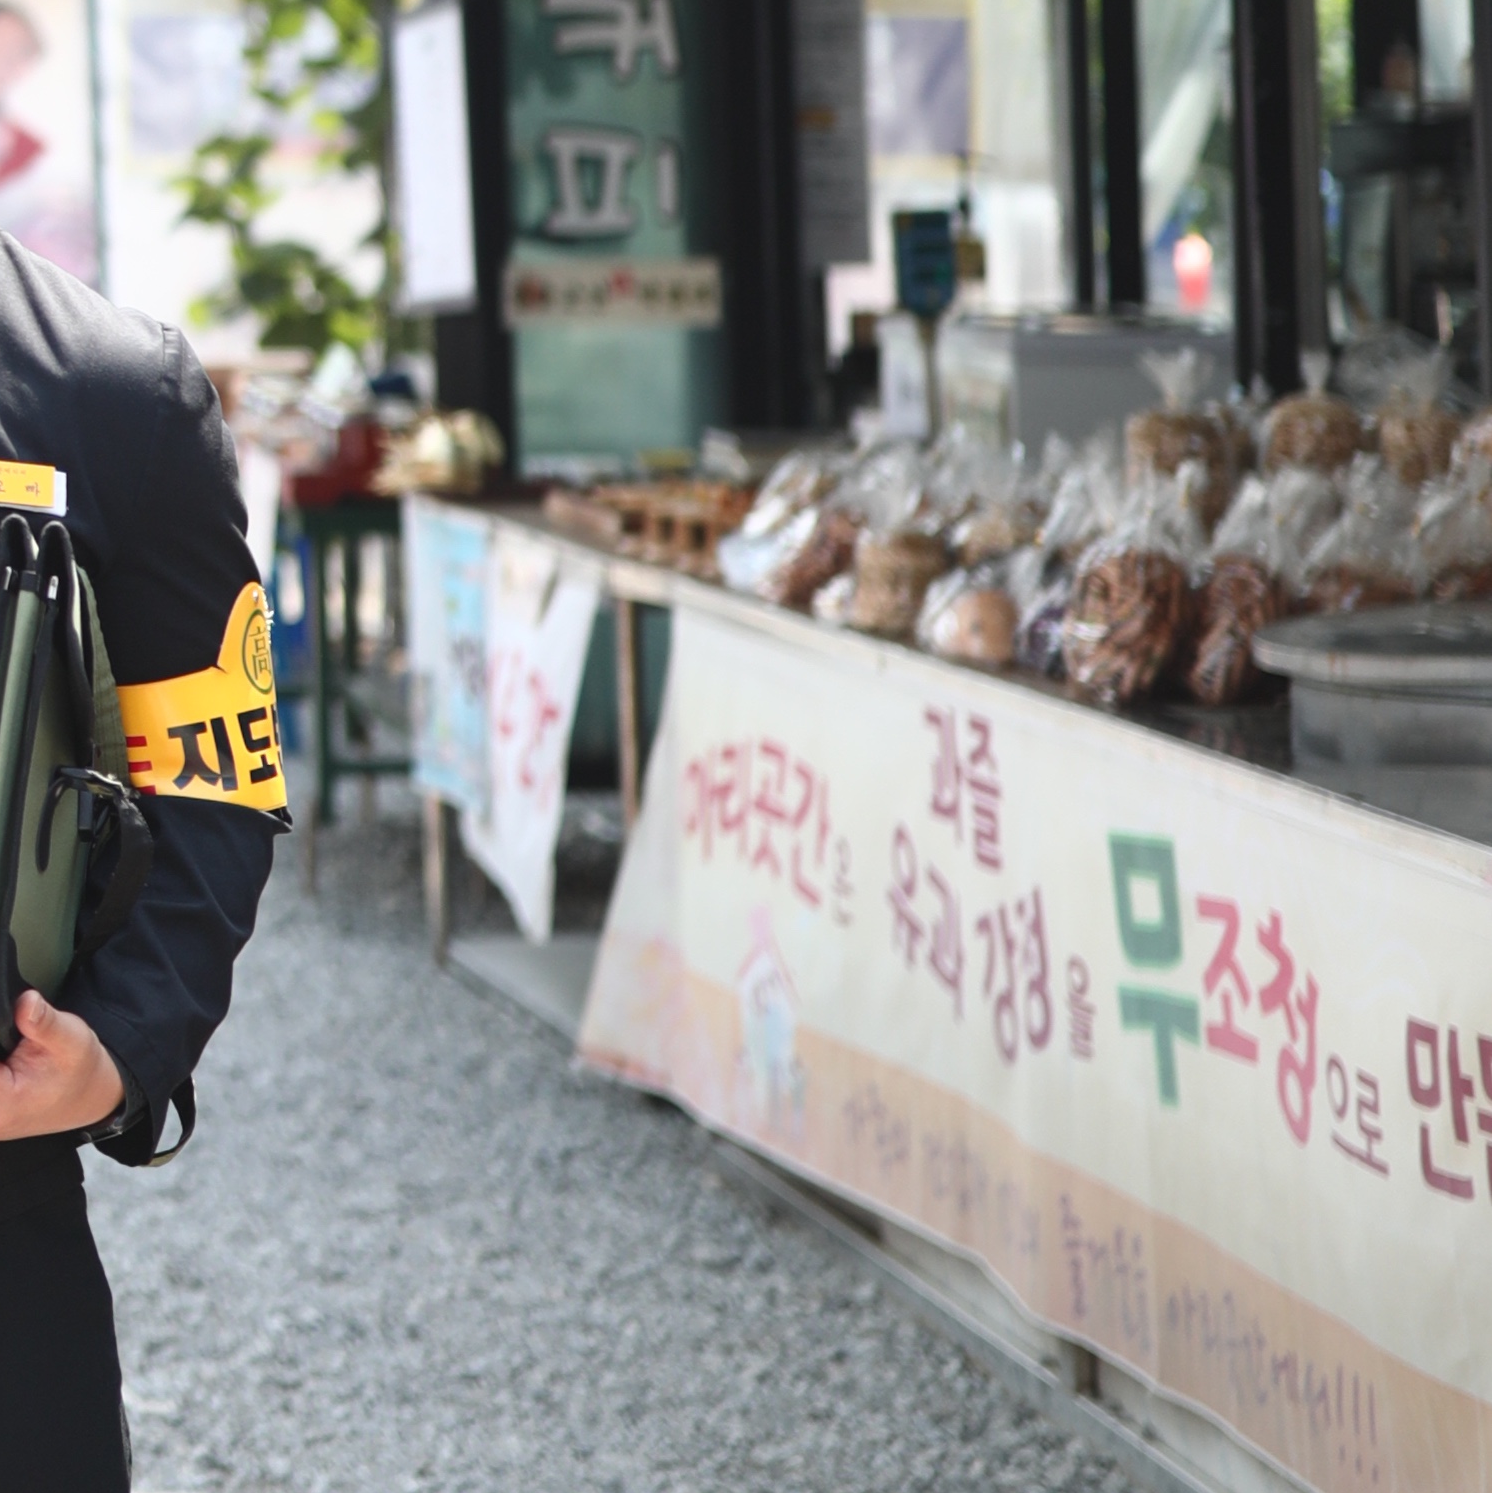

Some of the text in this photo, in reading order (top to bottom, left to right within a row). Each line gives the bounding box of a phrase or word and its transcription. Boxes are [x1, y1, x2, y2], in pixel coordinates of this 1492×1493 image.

[167, 704, 282, 792] 지도
[923, 706, 1003, 872] 과즐
[886, 822, 1096, 1066] 유과 강정을
[1107, 828, 1492, 1209] 무조청으로 만
